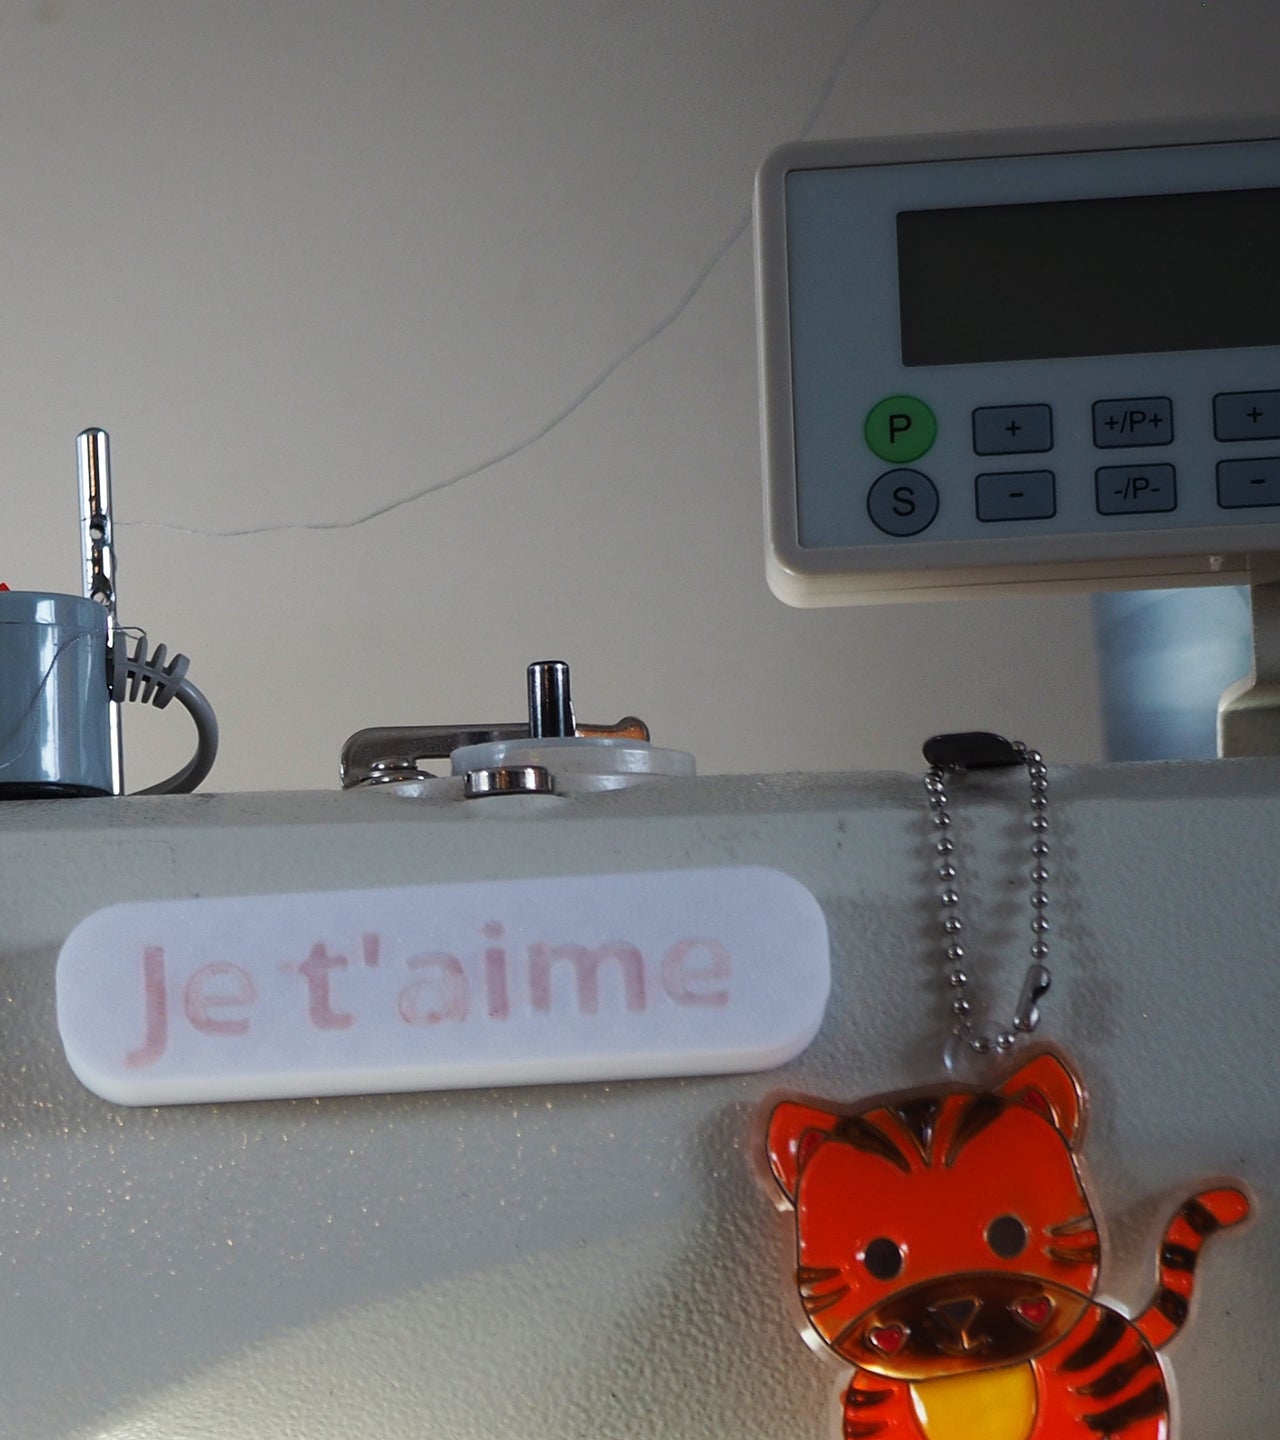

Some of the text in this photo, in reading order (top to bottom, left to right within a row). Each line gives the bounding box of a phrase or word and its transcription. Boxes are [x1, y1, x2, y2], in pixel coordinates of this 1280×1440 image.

[888, 413, 912, 444] P
[1104, 410, 1163, 433] +/P+
[892, 486, 916, 517] S
[123, 921, 733, 1069] Je t'aime
